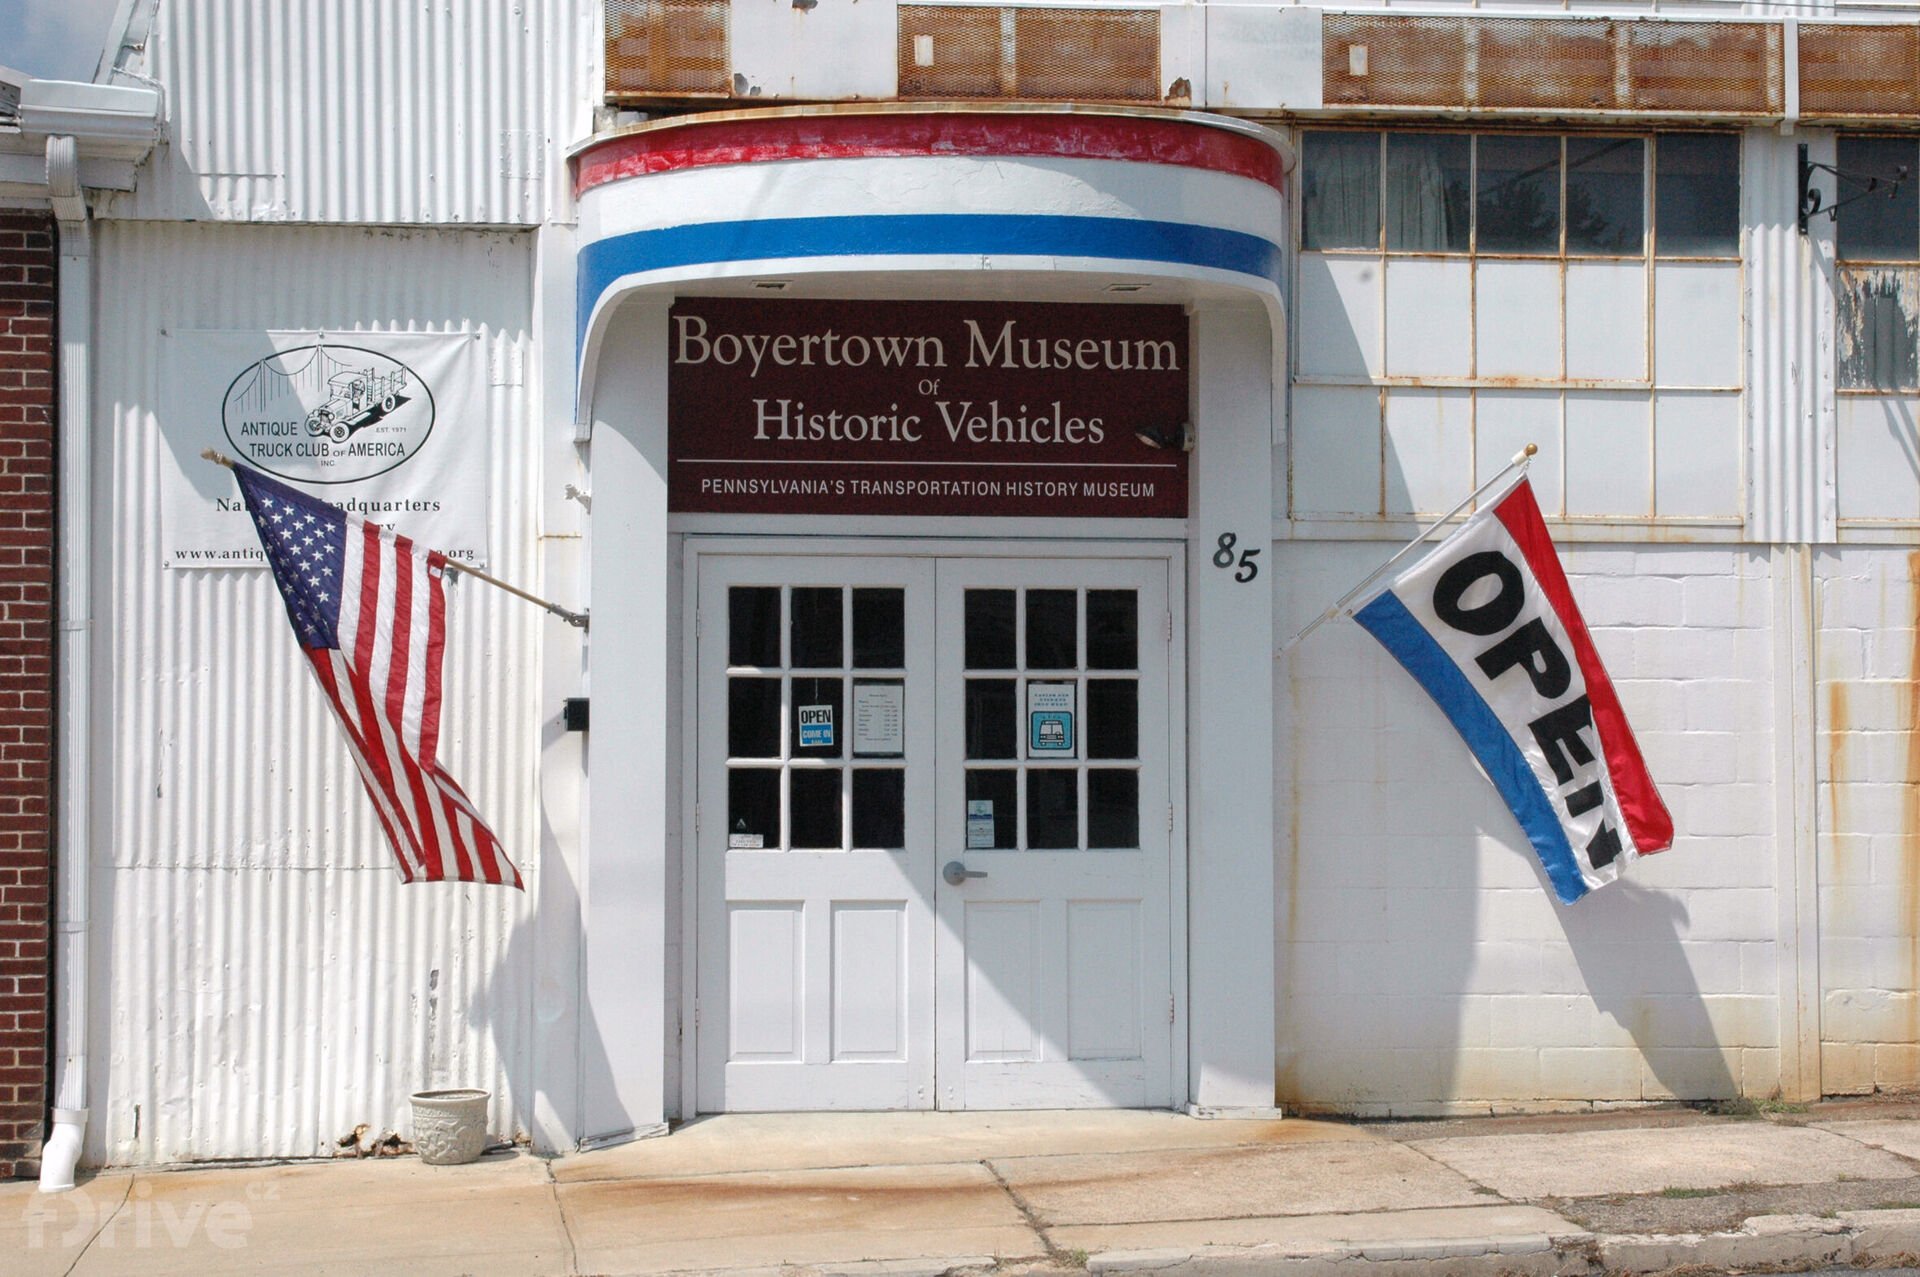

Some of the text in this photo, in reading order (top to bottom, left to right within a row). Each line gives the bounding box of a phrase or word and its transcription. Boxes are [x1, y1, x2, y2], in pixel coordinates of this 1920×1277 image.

[673, 315, 1181, 379] Boyertown Museum
[918, 378, 941, 396] Of
[241, 421, 298, 436] ANTIQUE
[752, 398, 1105, 445] Historic Vehicles
[249, 443, 293, 457] TRUCK
[296, 443, 329, 457] CLUB
[349, 443, 405, 457] AMERICA
[701, 478, 1155, 498] PENNSYLVANIA'S TRANSPORTATION HISTORY MUSEUM
[1212, 532, 1261, 584] 85
[800, 709, 832, 724] OPEN
[803, 729, 823, 739] COME
